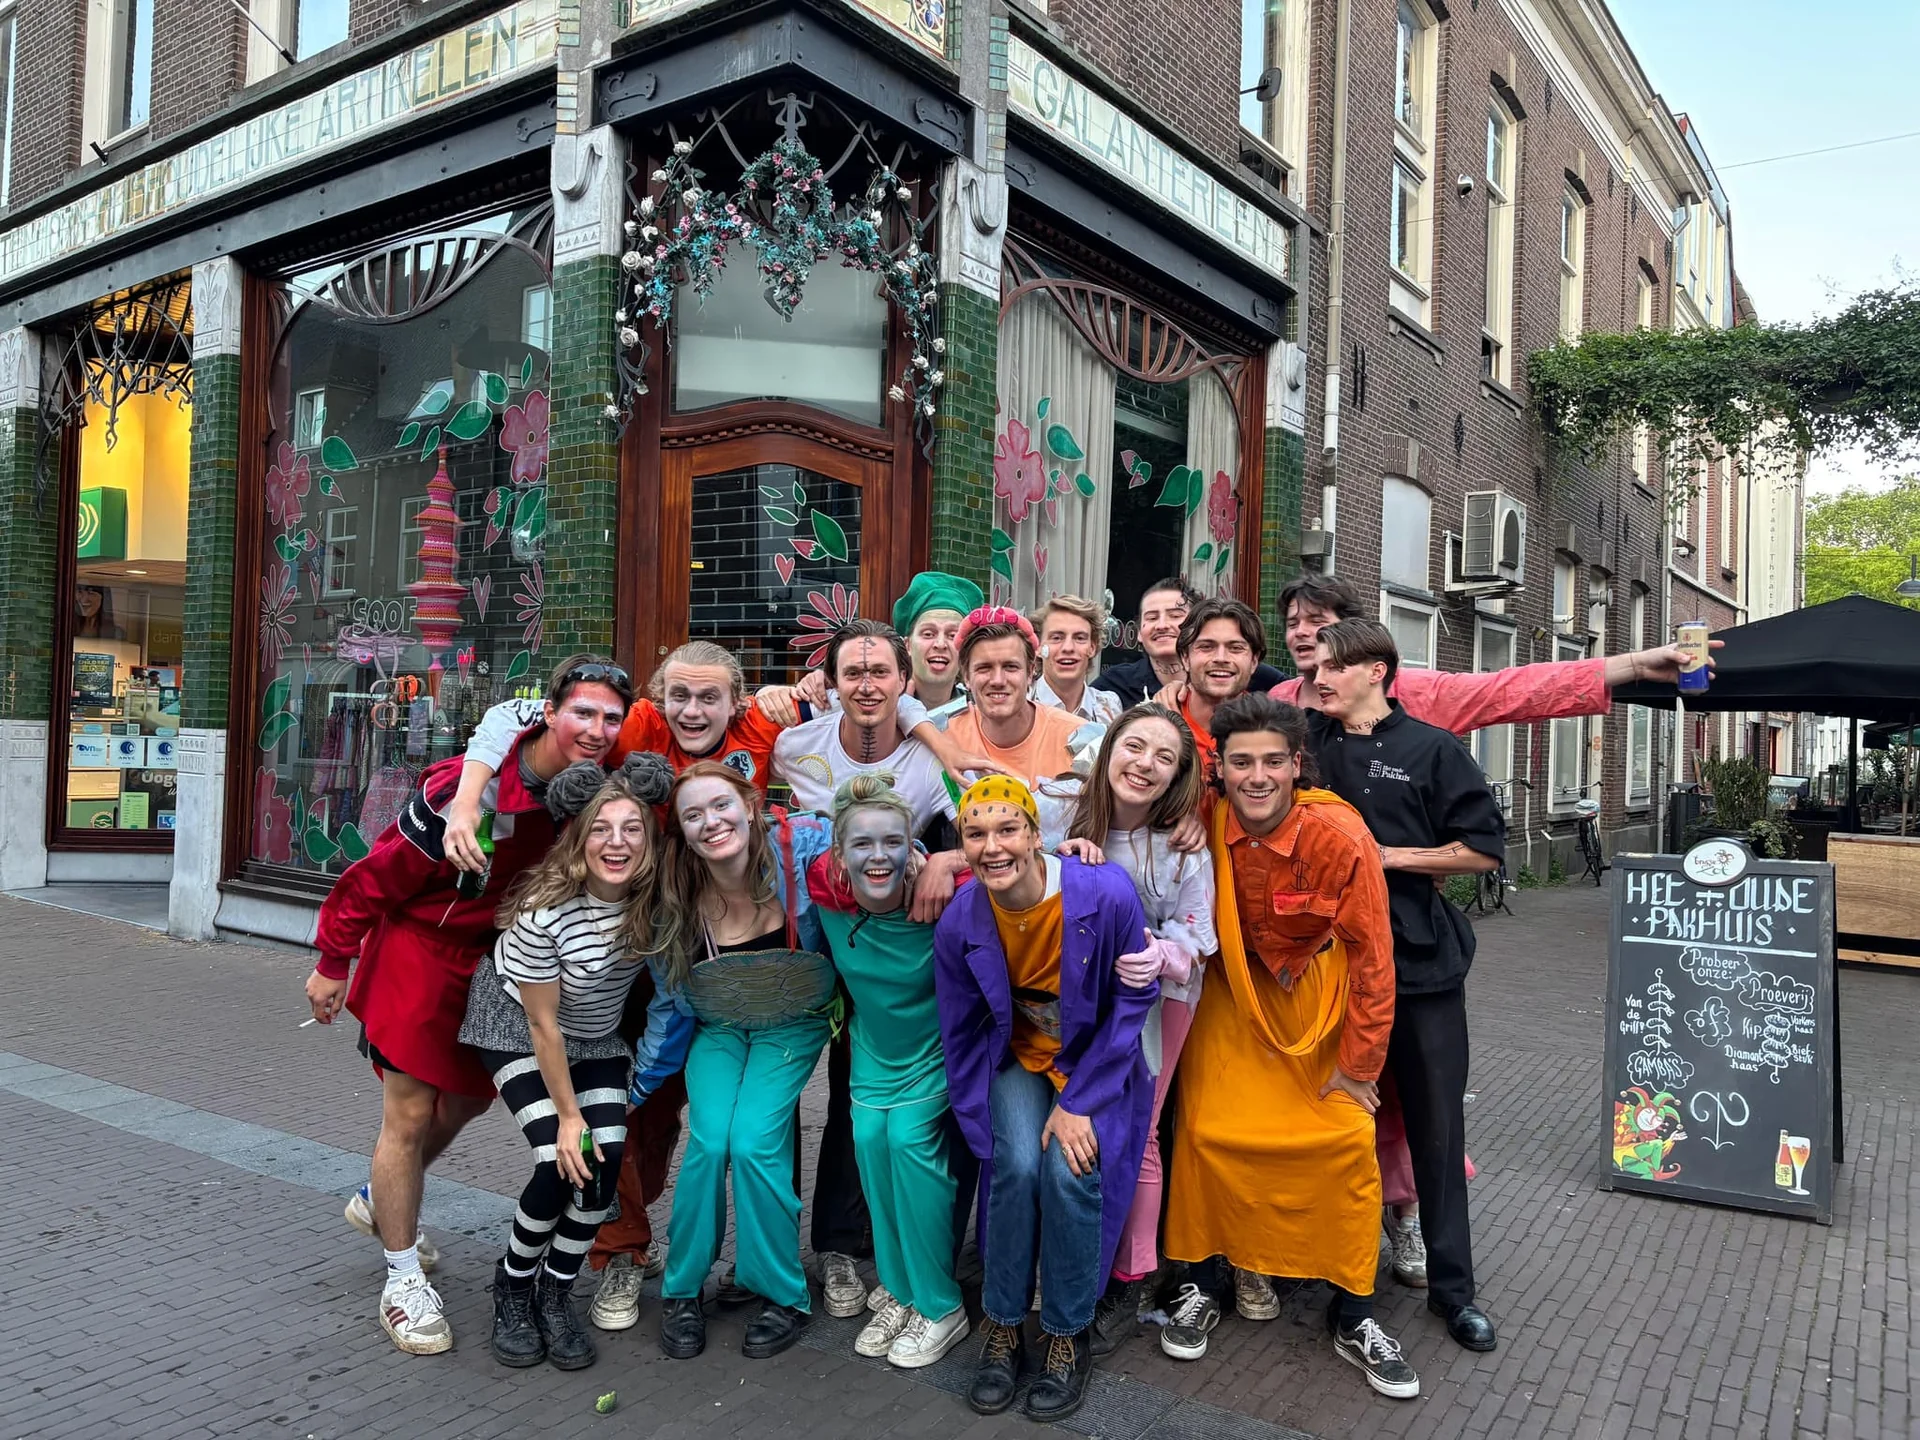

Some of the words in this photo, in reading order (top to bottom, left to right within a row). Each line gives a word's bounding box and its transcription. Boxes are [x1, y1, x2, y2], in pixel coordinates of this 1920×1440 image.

[315, 8, 517, 146] ARTIKELEN
[352, 597, 419, 634] SOOF
[1381, 771, 1411, 782] Pakhuis
[1626, 871, 1686, 907] HET
[1728, 876, 1815, 914] OUDE
[1644, 906, 1774, 946] PAKHUIS
[1688, 947, 1741, 970] Probeer
[1697, 968, 1733, 980] onze:
[1625, 994, 1643, 1009] Van
[1749, 977, 1809, 1009] Proeverij
[1626, 1008, 1641, 1020] de
[1693, 1003, 1725, 1038] of
[1742, 1017, 1763, 1040] Kip
[1794, 1025, 1814, 1034] haas
[1724, 1044, 1764, 1063] Diamant
[1634, 1056, 1682, 1081] GAMBA'S
[1730, 1059, 1759, 1072] haas
